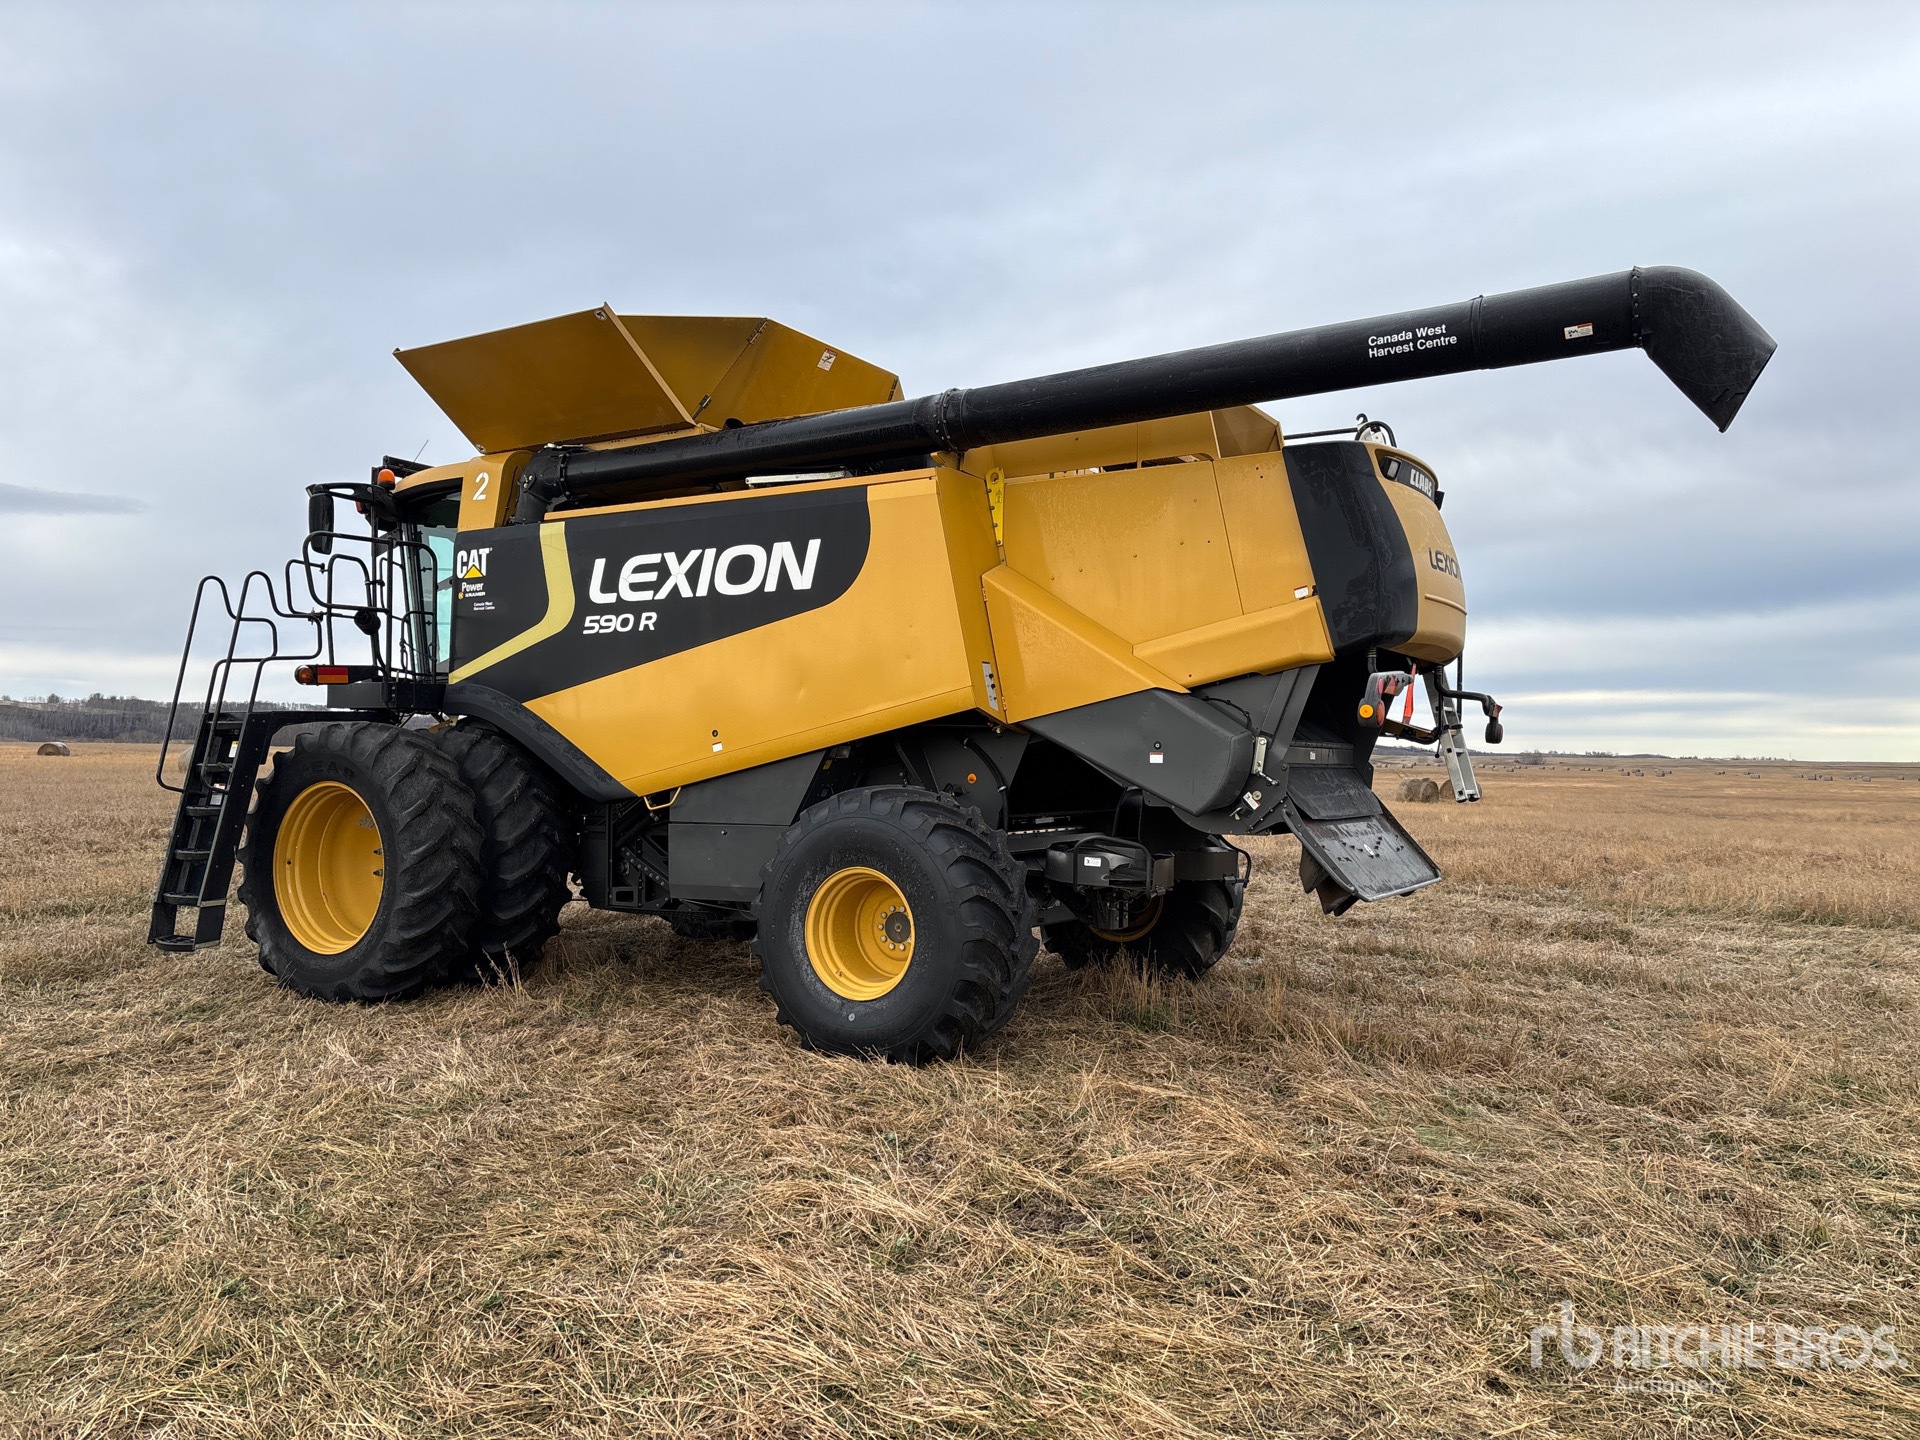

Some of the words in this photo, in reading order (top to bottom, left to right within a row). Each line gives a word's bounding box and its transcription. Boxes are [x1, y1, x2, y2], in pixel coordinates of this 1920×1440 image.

[1367, 330, 1413, 346] Canada
[1415, 323, 1447, 338] West
[1368, 341, 1415, 359] Harvest
[1416, 335, 1458, 350] Centre
[472, 471, 490, 501] 2
[1409, 467, 1433, 498] CLAAS
[456, 547, 490, 579] CAT
[588, 538, 822, 605] LEXION
[461, 581, 485, 593] Power
[582, 612, 636, 635] 590
[638, 610, 659, 632] R
